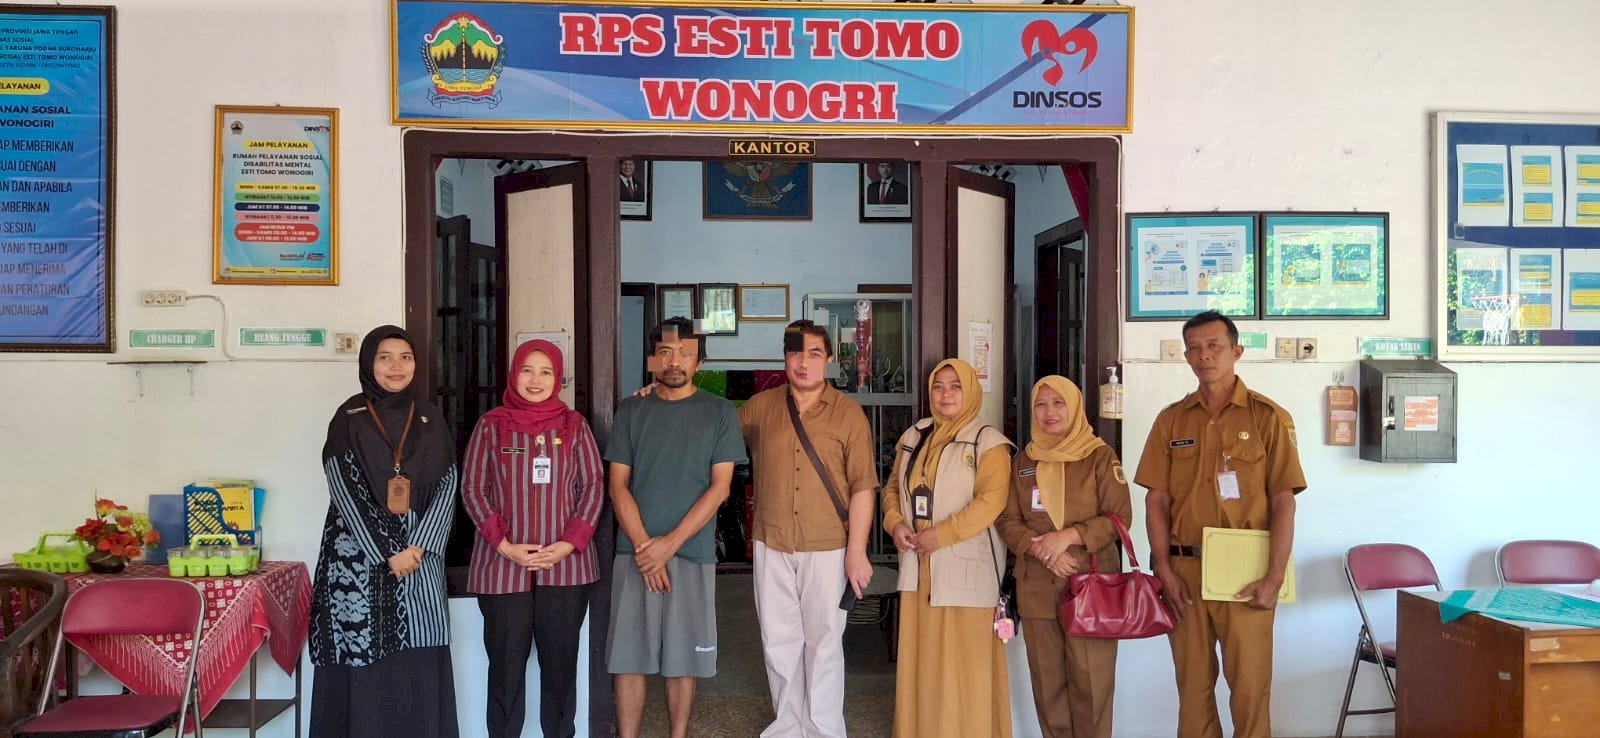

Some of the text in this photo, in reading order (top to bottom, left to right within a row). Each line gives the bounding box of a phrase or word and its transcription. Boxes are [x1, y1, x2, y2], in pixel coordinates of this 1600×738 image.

[560, 12, 962, 61] RPS ESTI TOMO
[640, 77, 898, 121] WONOGRI
[1013, 90, 1102, 108] DINSOS
[32, 106, 71, 114] SOSIAL
[12, 140, 74, 152] MEMBERIKAN
[734, 142, 810, 154] KANTOR
[18, 160, 56, 172] DENGAN
[12, 181, 30, 192] DAN
[34, 182, 72, 192] APABILA
[4, 222, 36, 234] SESUAI
[1, 243, 68, 255] YANG TELAH DI
[18, 264, 66, 275] MENERIMA
[16, 284, 70, 296] PERATURAN
[147, 334, 196, 344] CHARGER HP
[254, 333, 312, 343] RUANG TUNGGU
